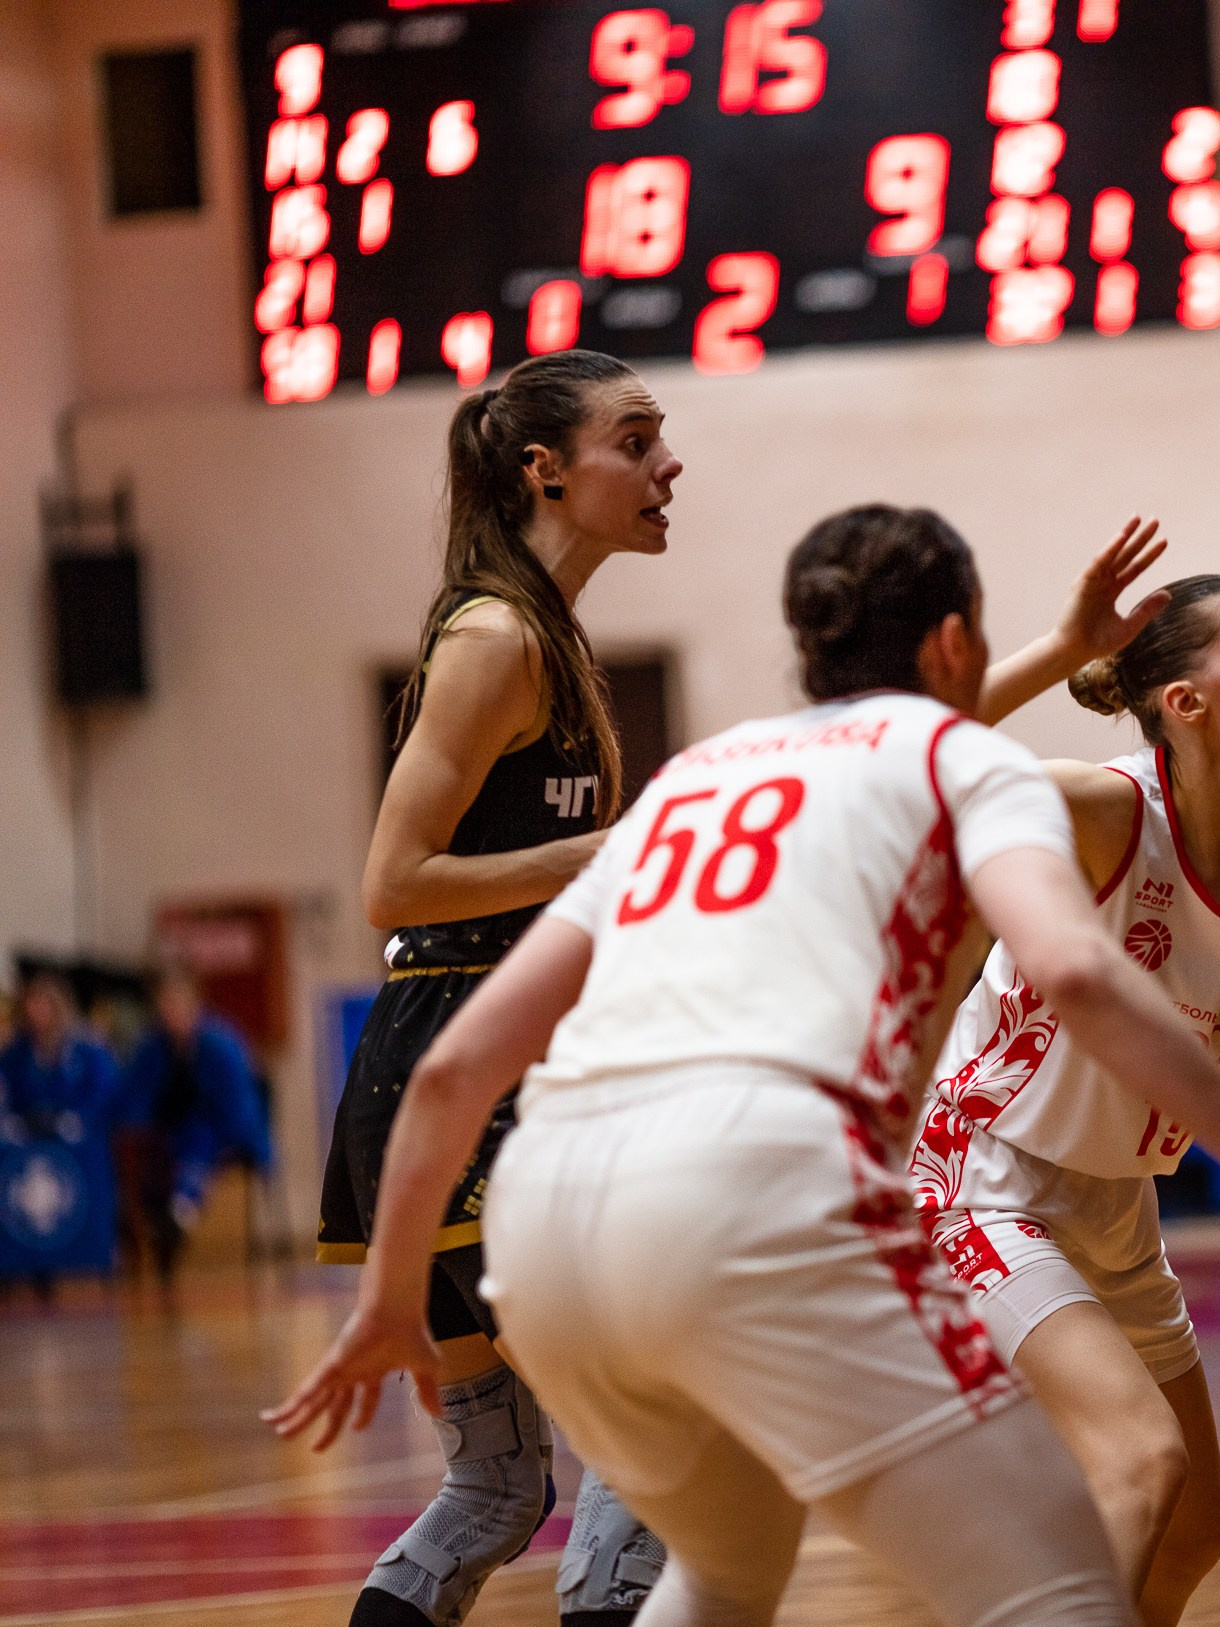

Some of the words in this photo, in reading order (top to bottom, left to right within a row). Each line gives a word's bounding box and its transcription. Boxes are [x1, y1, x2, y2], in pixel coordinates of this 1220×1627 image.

[580, 155, 691, 279] 18
[865, 132, 951, 257] 9
[692, 250, 780, 376] 2
[906, 253, 948, 327] 1
[615, 777, 806, 927] 58
[1134, 891, 1174, 909] SPORT
